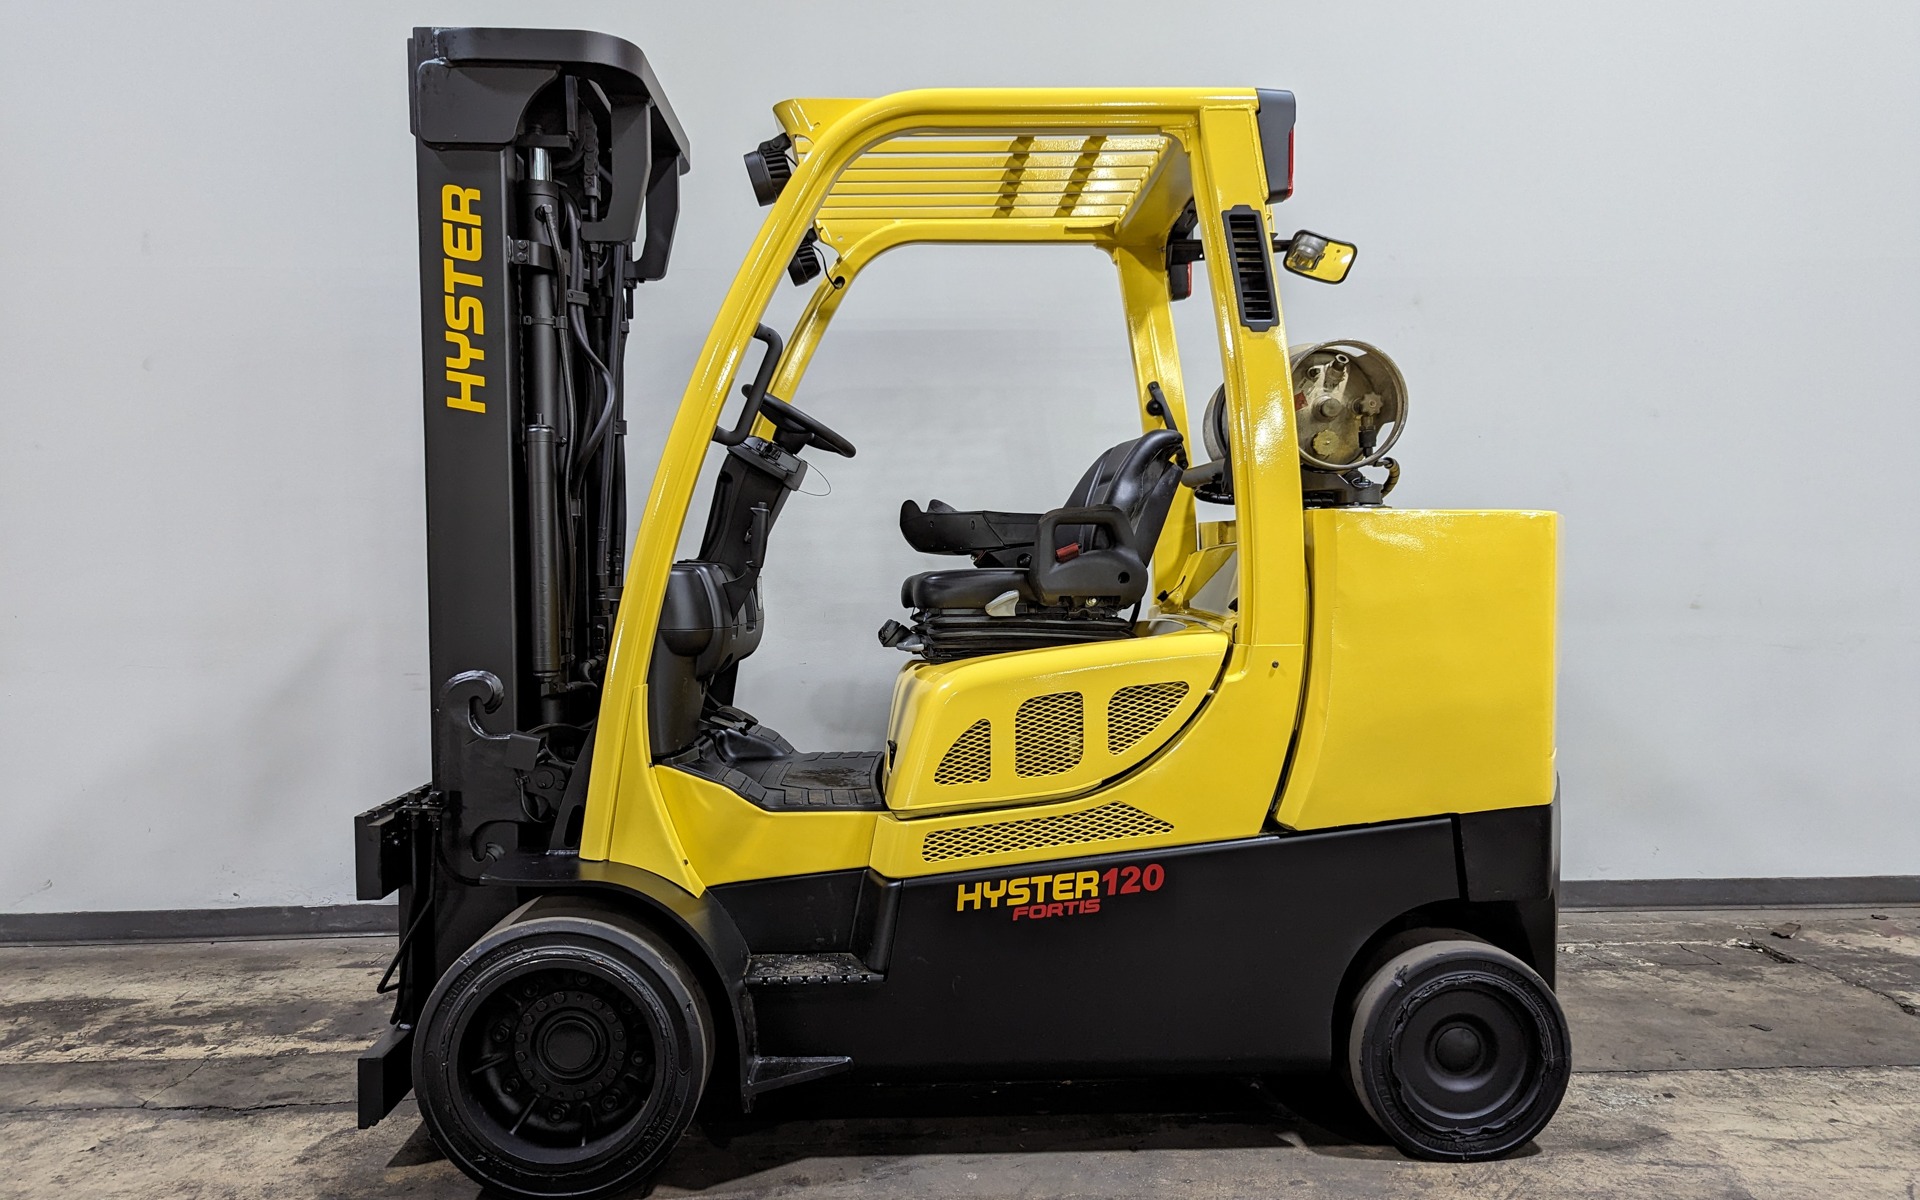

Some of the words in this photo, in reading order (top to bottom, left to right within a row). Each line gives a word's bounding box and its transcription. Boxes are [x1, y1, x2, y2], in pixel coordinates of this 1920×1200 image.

[441, 184, 486, 414] HYSTER
[956, 870, 1100, 912] HYSTER
[1101, 863, 1165, 896] 120
[1012, 898, 1100, 921] FORTIS
